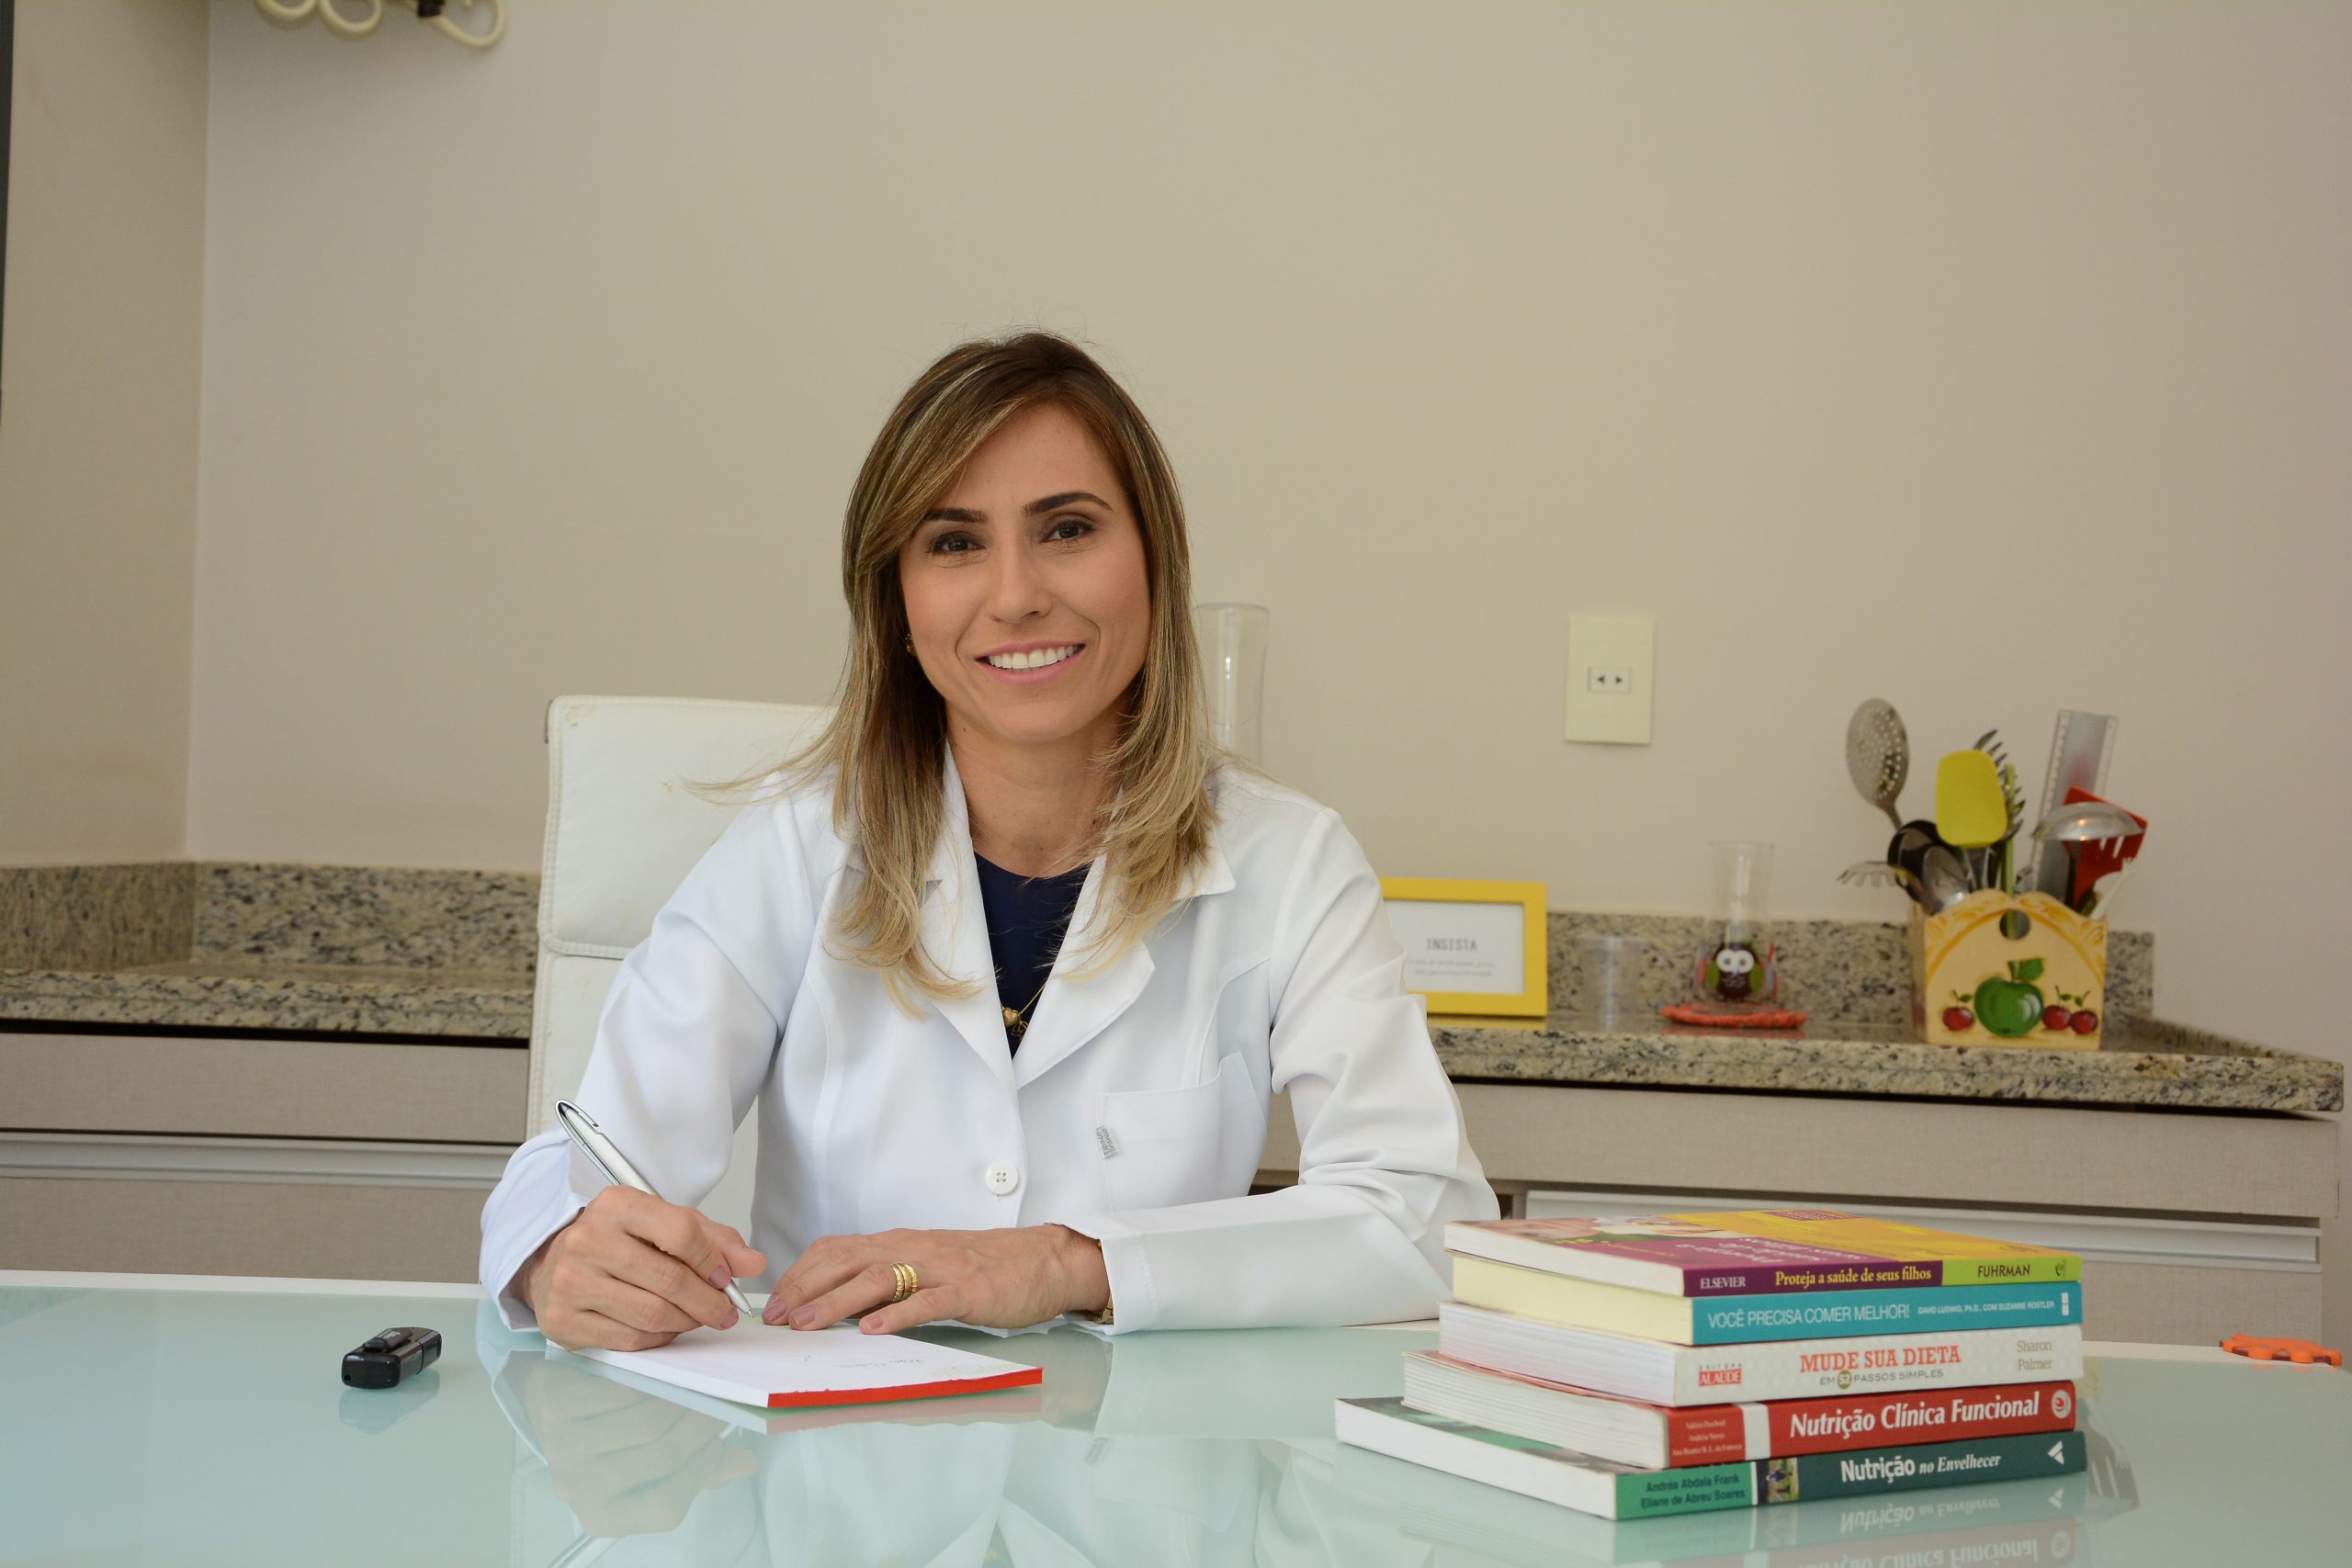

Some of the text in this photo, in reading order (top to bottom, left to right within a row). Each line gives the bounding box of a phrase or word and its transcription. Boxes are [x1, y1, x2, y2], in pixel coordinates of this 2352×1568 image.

[1427, 938, 1478, 952] INSISTA
[1775, 1265, 1932, 1289] Proteja a saúde de seus filhos
[1977, 1264, 2030, 1278] FUHRMAN
[1700, 1276, 1746, 1290] ELSEVIER
[1918, 1306, 1937, 1314] DAVID
[1983, 1303, 1997, 1312] COM
[1998, 1302, 2027, 1311] SUZANNE
[2028, 1301, 2055, 1309] ROSTLER
[1708, 1303, 1910, 1328] VOCÊ PRECISA COMER MELHOR!
[2017, 1340, 2052, 1353] Sharon
[1800, 1346, 1962, 1372] MUDE SUA DIETA
[2018, 1359, 2053, 1371] Palmer
[1820, 1370, 1944, 1385] EM 52 PASSOS SIMPLES
[1790, 1391, 2040, 1439] Nutrição Clínica Funcional
[1840, 1453, 2002, 1483] Nutrição no Envelhecer
[1681, 1478, 1712, 1488] Abdala
[1714, 1474, 1739, 1484] Frank
[1641, 1489, 1745, 1507] Eliane de Abreu Soares
